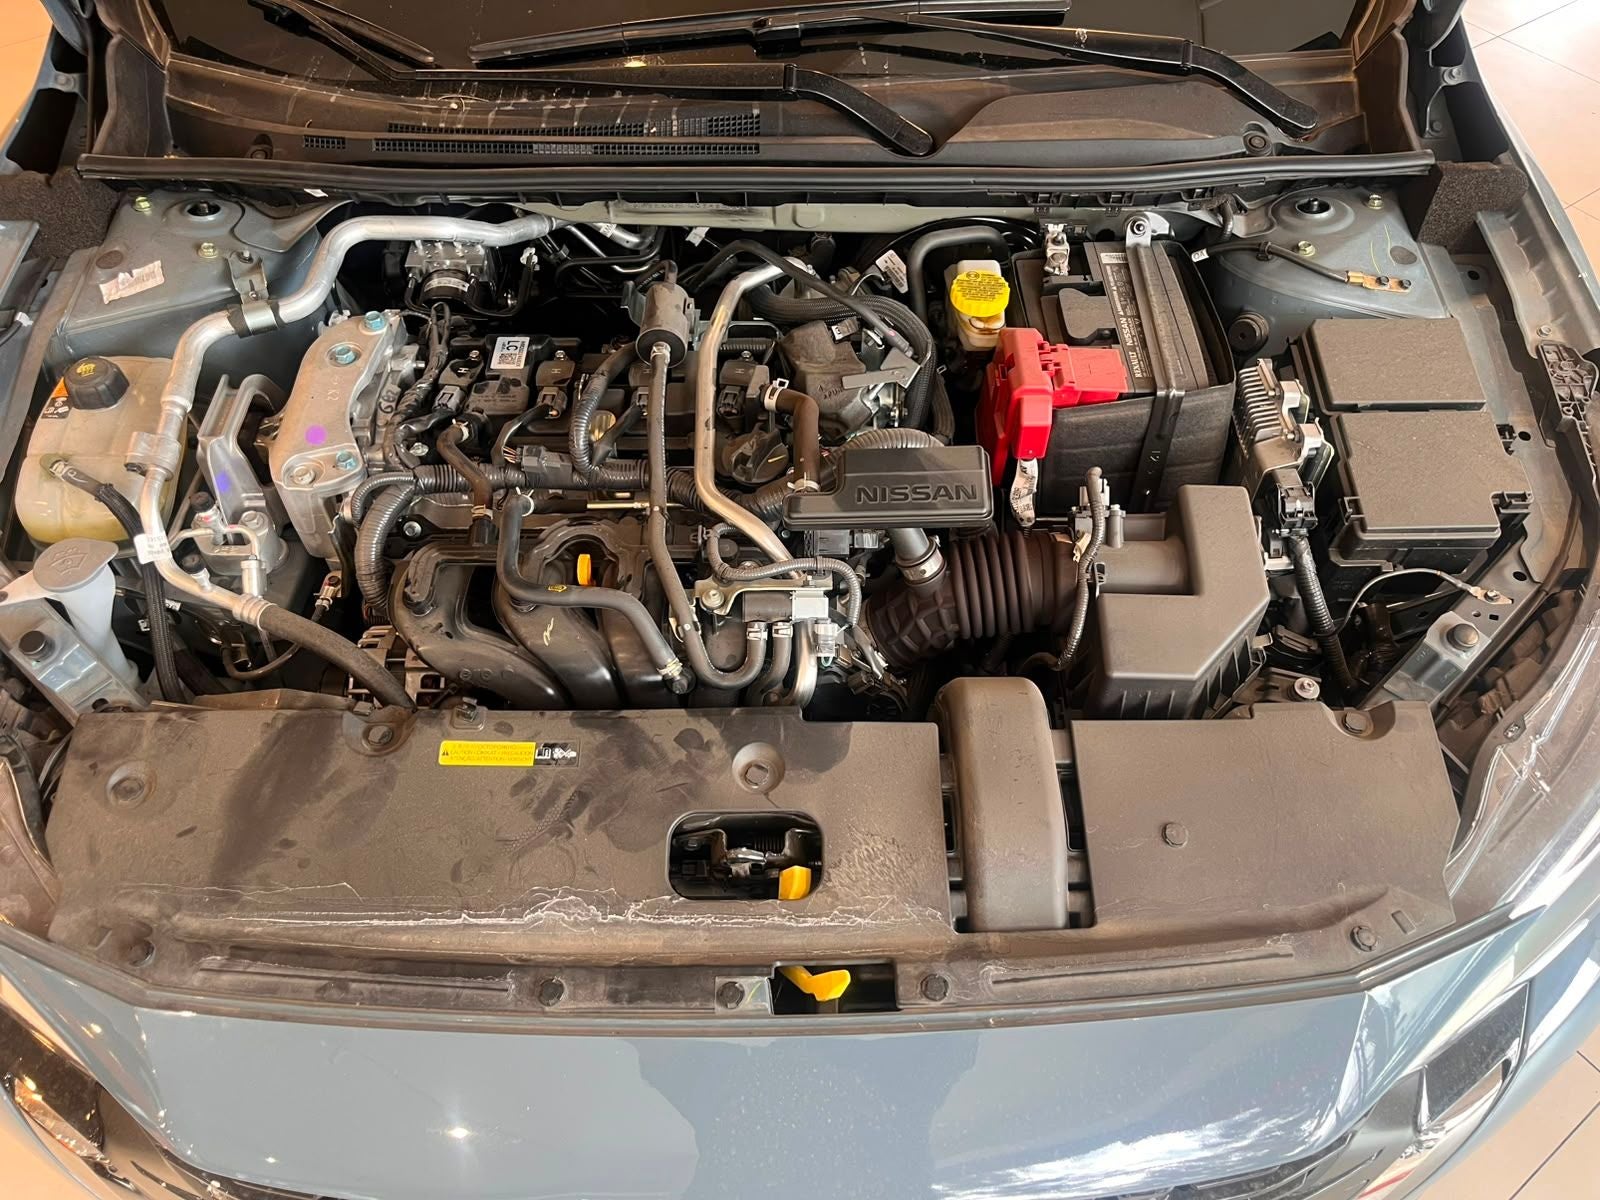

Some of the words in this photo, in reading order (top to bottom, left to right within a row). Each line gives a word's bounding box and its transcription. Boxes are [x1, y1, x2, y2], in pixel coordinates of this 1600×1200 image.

[1120, 317, 1134, 346] NISSAN
[506, 340, 520, 351] LC
[856, 484, 978, 503] NISSAN
